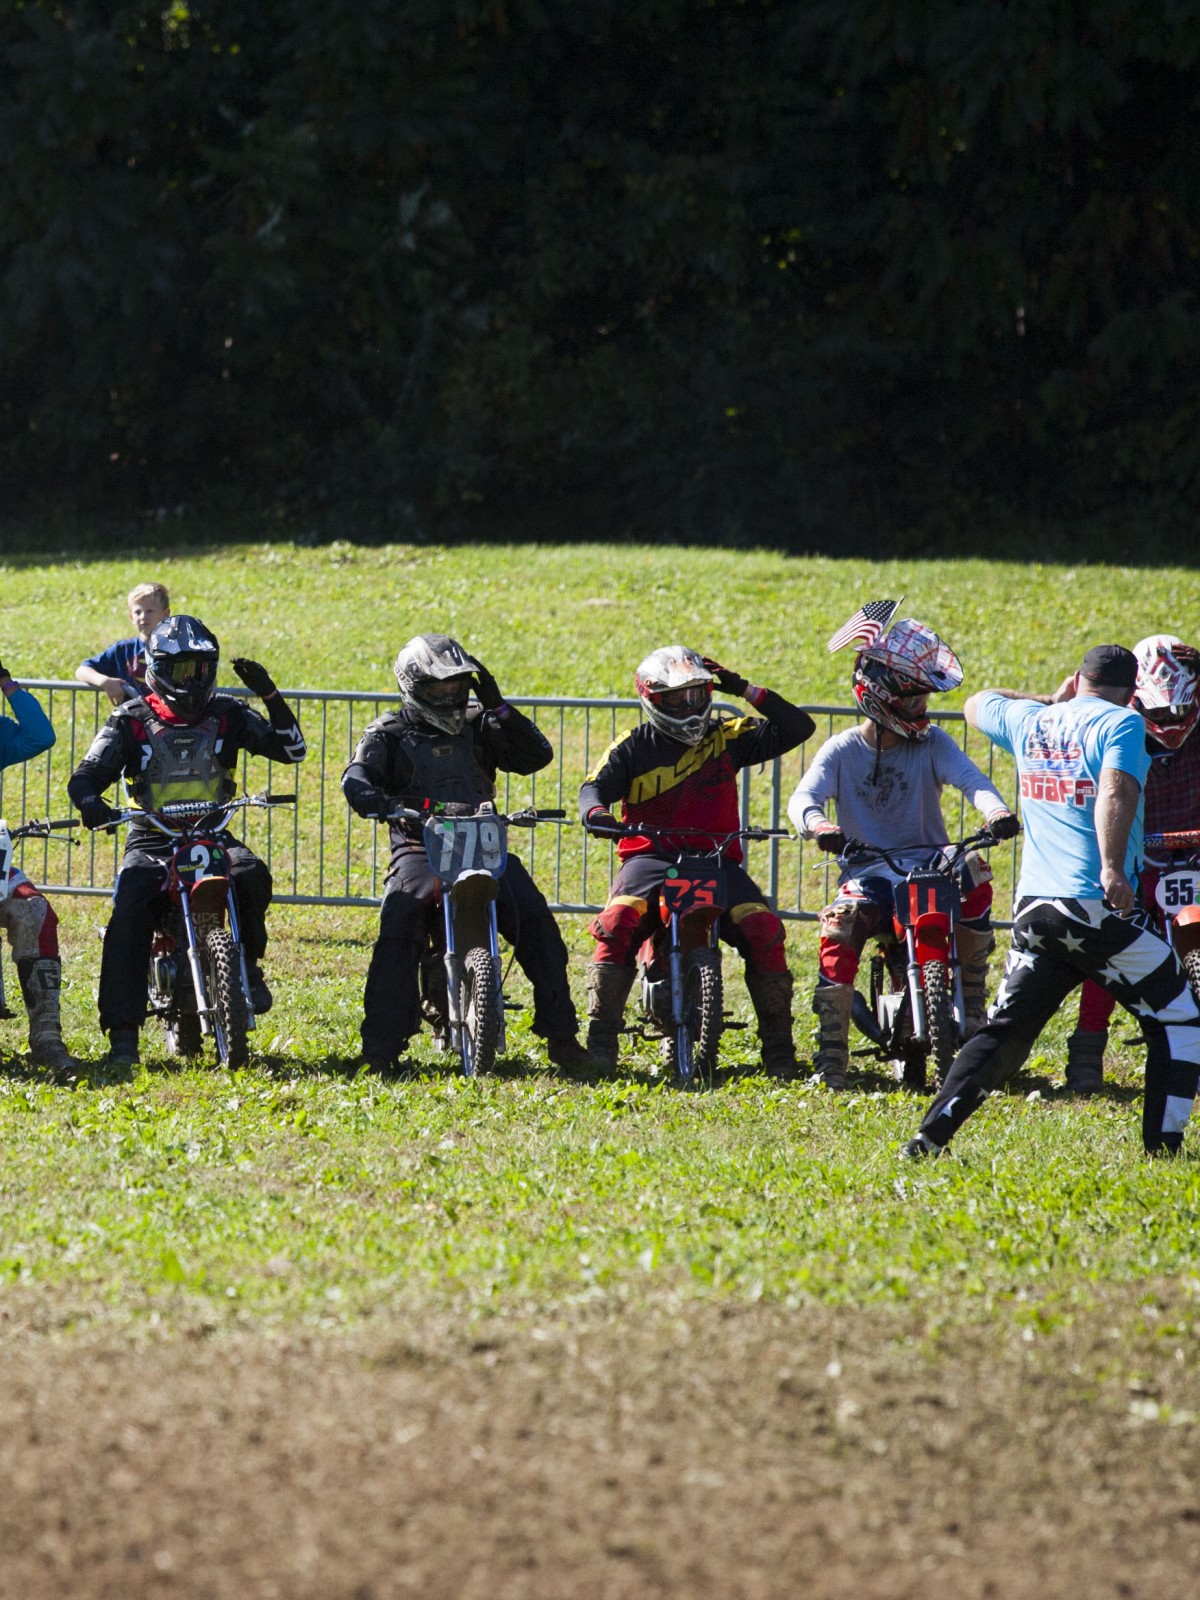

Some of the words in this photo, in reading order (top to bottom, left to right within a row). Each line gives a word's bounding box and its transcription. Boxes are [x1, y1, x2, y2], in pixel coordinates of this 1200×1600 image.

[162, 801, 212, 813] RENTHAL
[190, 844, 214, 882] 2
[433, 821, 502, 872] 779
[1165, 878, 1194, 906] 55
